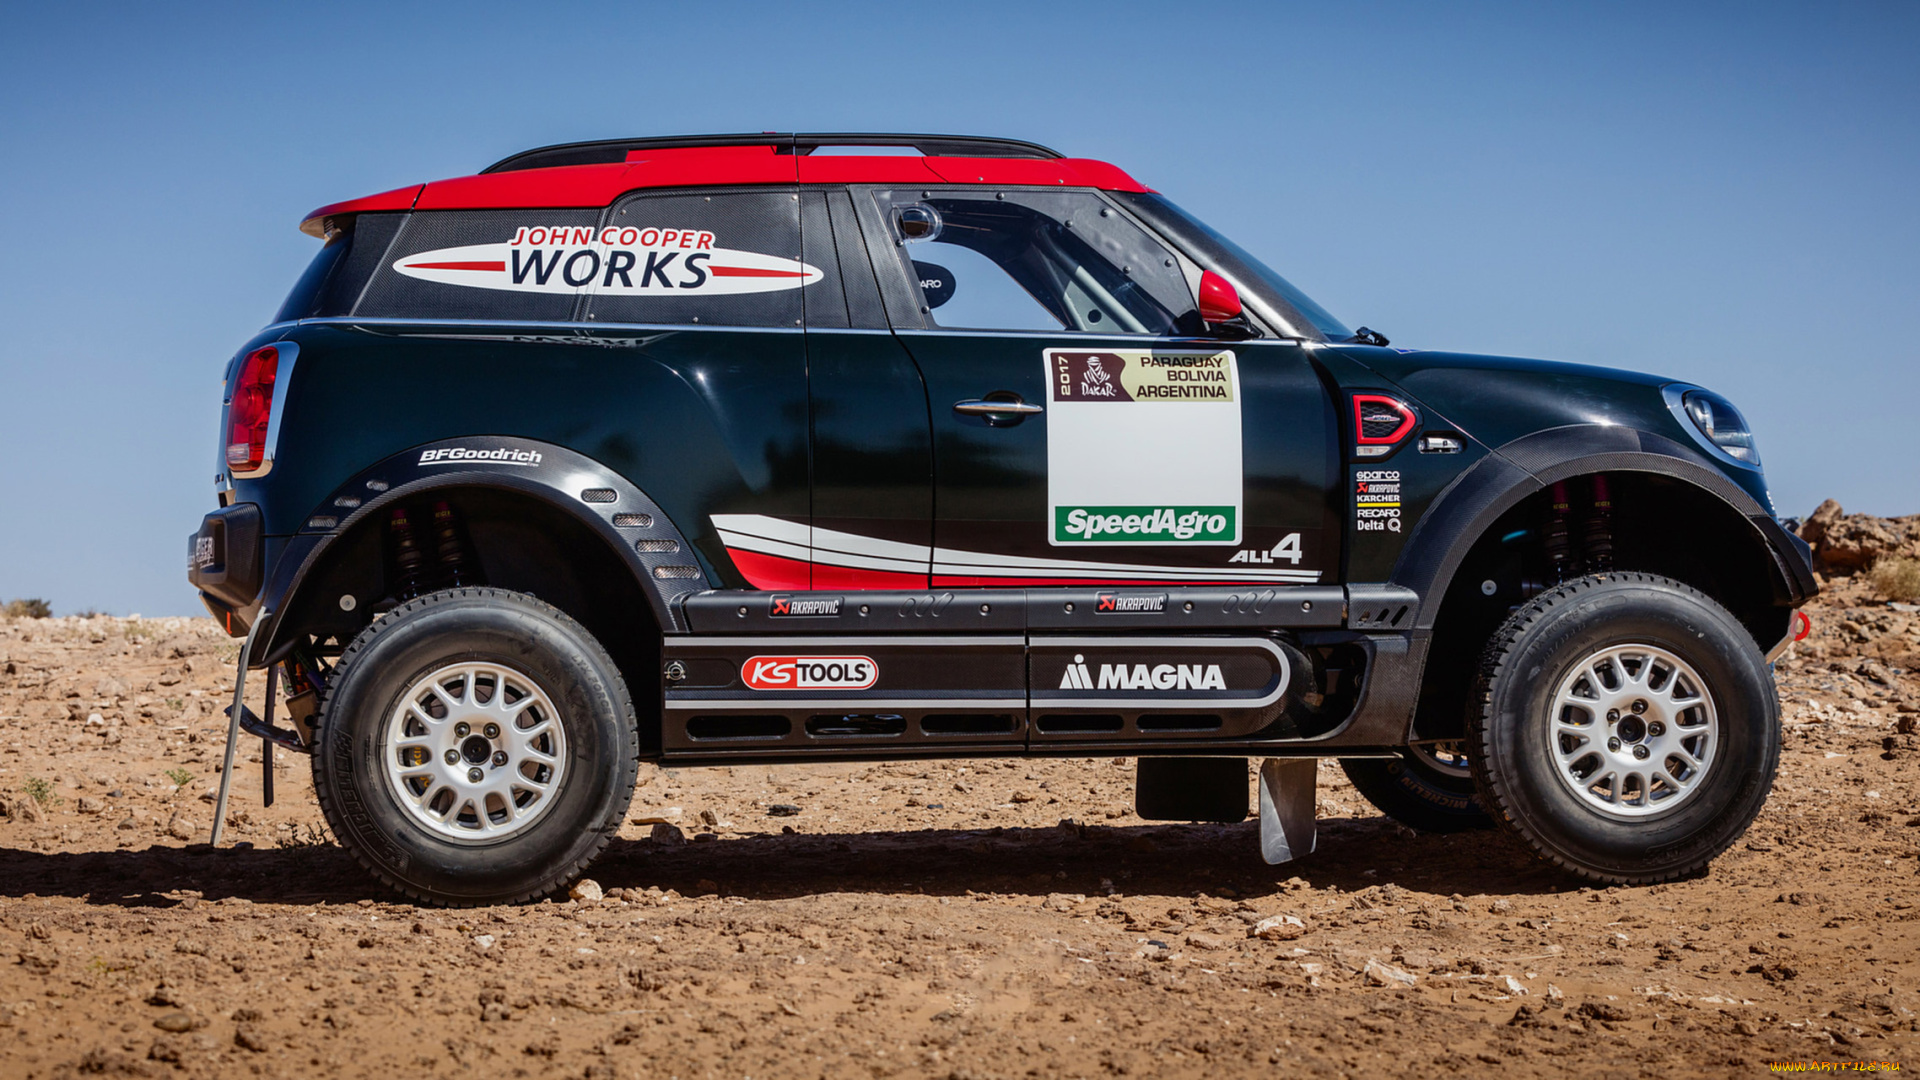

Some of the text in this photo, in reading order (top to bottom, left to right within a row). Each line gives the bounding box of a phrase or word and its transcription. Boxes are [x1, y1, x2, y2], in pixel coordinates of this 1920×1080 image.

[510, 228, 714, 250] JOHN COOPER
[511, 249, 711, 289] WORKS
[1140, 356, 1224, 368] PARAGUAY
[1057, 355, 1071, 396] 2017
[1166, 370, 1227, 382] BOLIVIA
[1136, 385, 1227, 398] ARGENTINA
[419, 447, 543, 463] BFGoodrich
[1356, 470, 1400, 482] sparco
[1357, 508, 1401, 518] RECARO
[1064, 508, 1227, 539] SpeedAgro
[1357, 519, 1385, 531] Delta
[795, 663, 868, 682] TOOLS
[1097, 663, 1227, 690] MAGNA
[1399, 776, 1469, 810] MICHELIN
